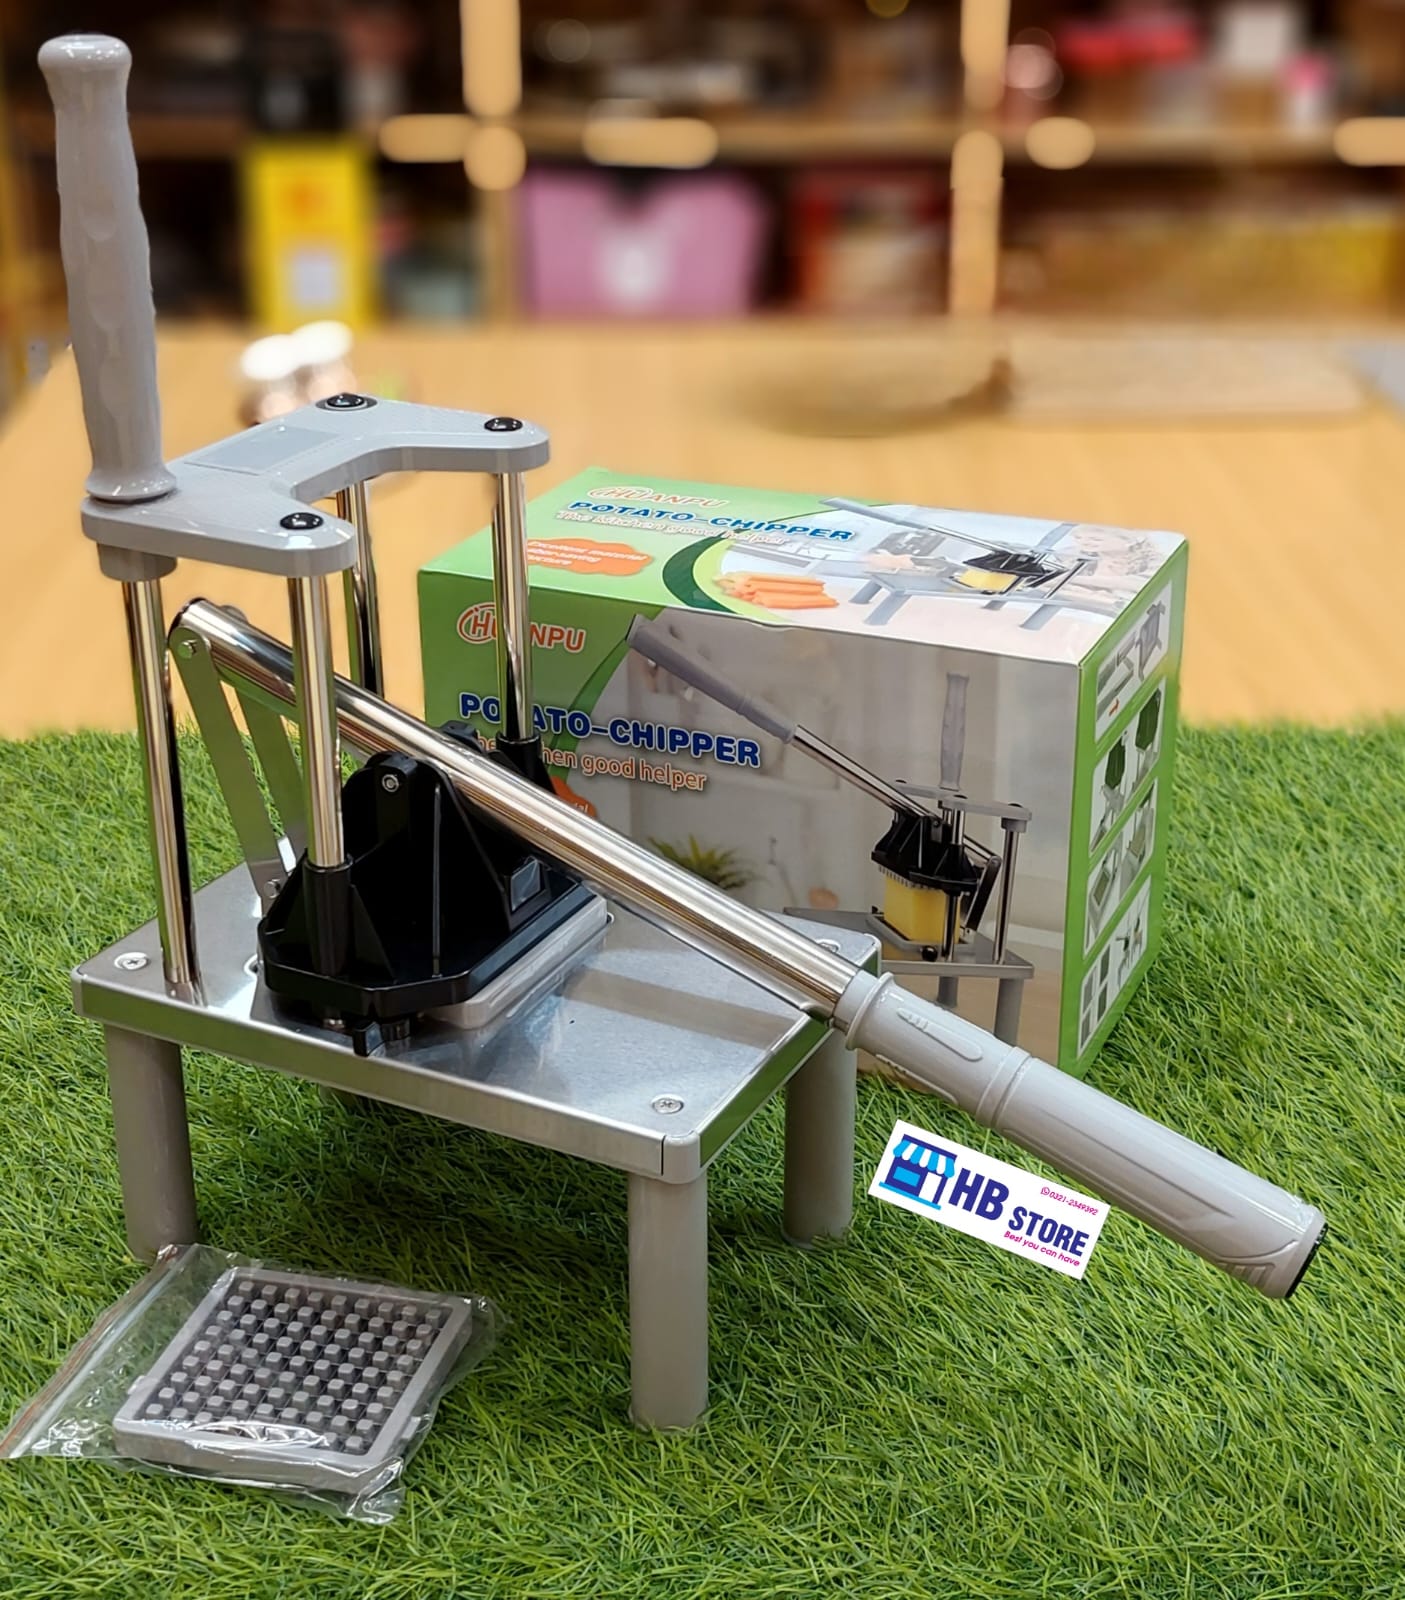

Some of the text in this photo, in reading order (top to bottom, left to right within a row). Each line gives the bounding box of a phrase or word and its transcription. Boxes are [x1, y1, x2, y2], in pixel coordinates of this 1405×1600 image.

[587, 486, 729, 508] HUANPU
[460, 692, 760, 766] POATO-CHIPPER
[581, 751, 635, 777] good
[639, 761, 706, 791] helper
